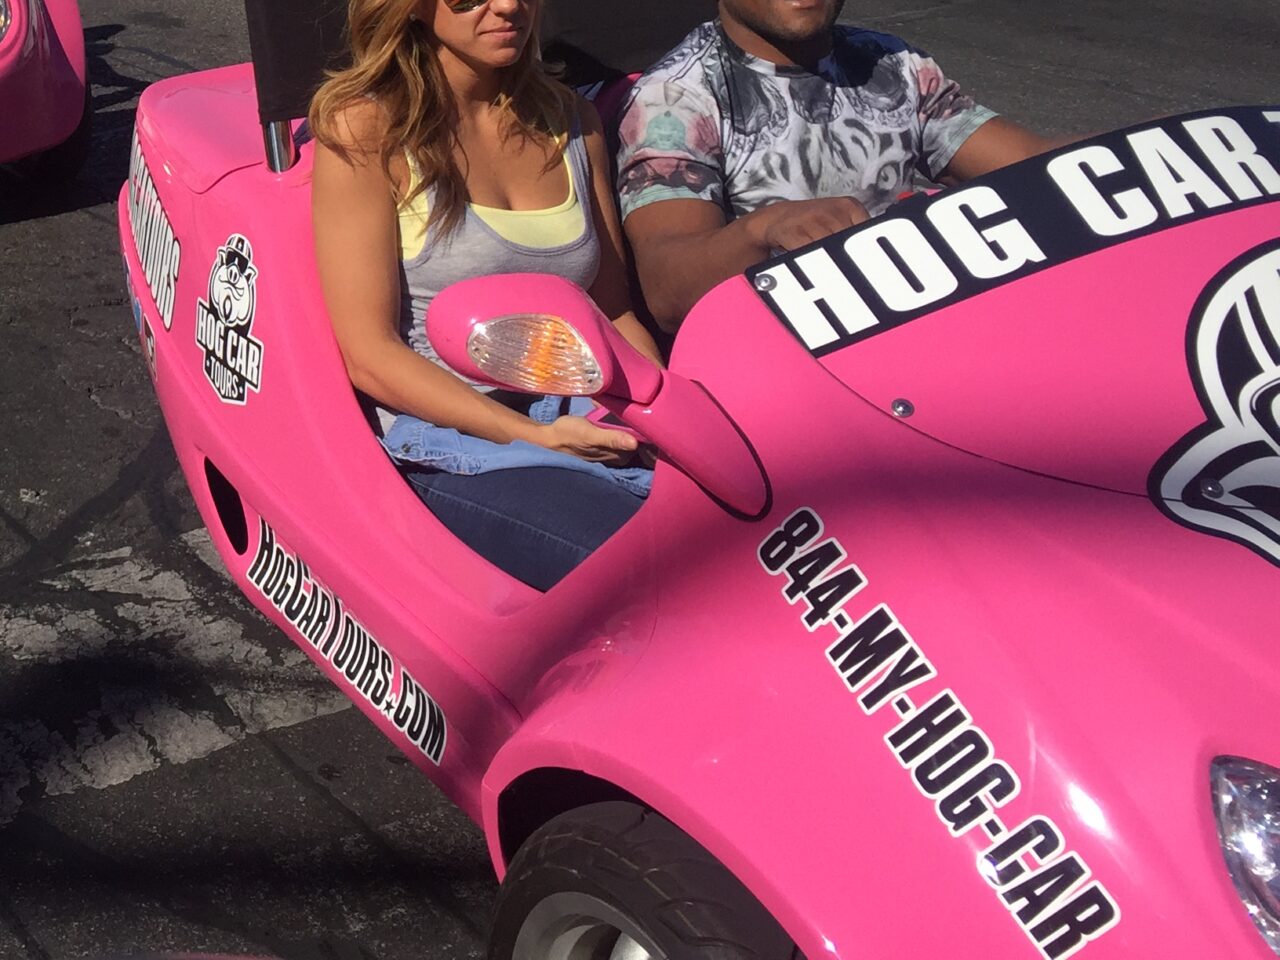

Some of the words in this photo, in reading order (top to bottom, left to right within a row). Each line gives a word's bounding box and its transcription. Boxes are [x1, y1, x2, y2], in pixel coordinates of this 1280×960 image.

[764, 185, 1047, 350] HOG
[1047, 116, 1280, 236] CAR
[197, 304, 226, 360] HOG
[226, 328, 262, 386] CAR
[209, 357, 240, 399] TOURS
[759, 508, 1118, 959] 844-MY-HOG-CAR
